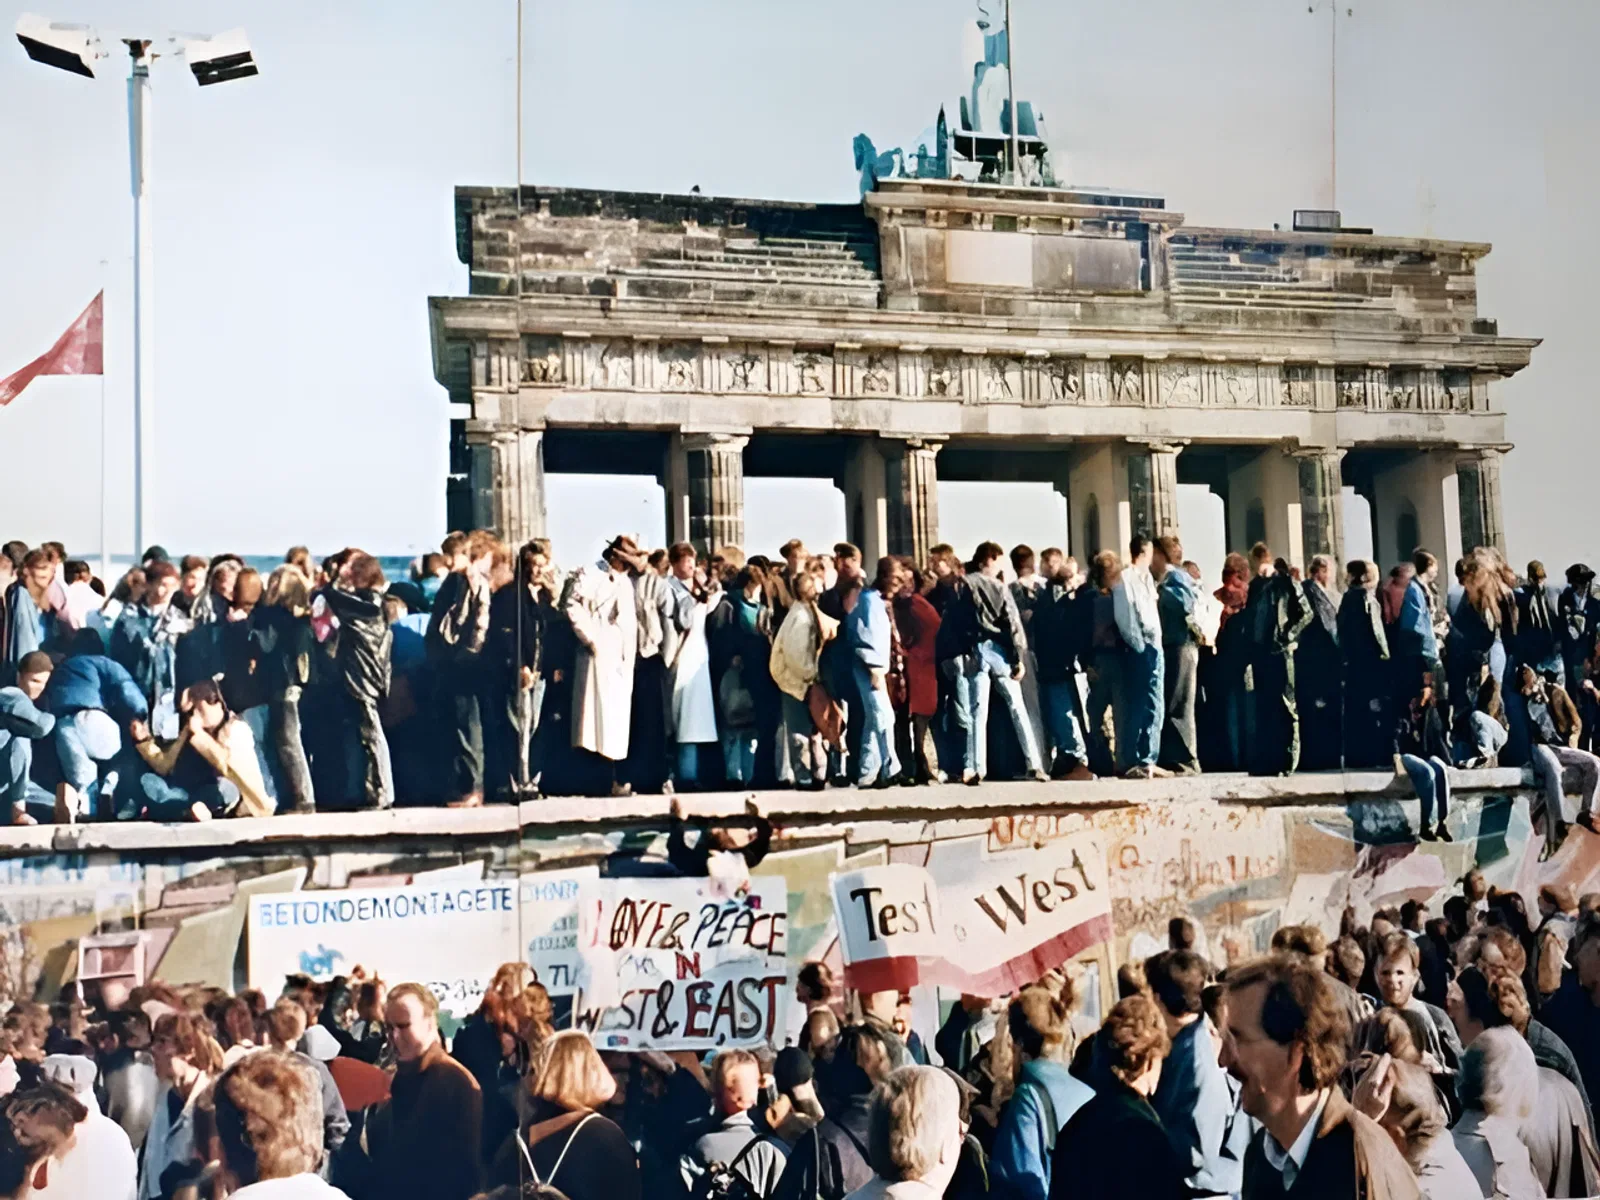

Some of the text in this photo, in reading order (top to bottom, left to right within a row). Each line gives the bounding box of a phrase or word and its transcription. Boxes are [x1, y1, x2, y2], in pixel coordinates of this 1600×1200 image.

[973, 847, 1096, 936] West
[691, 902, 788, 958] PEACE
[682, 975, 788, 1040] EAST
